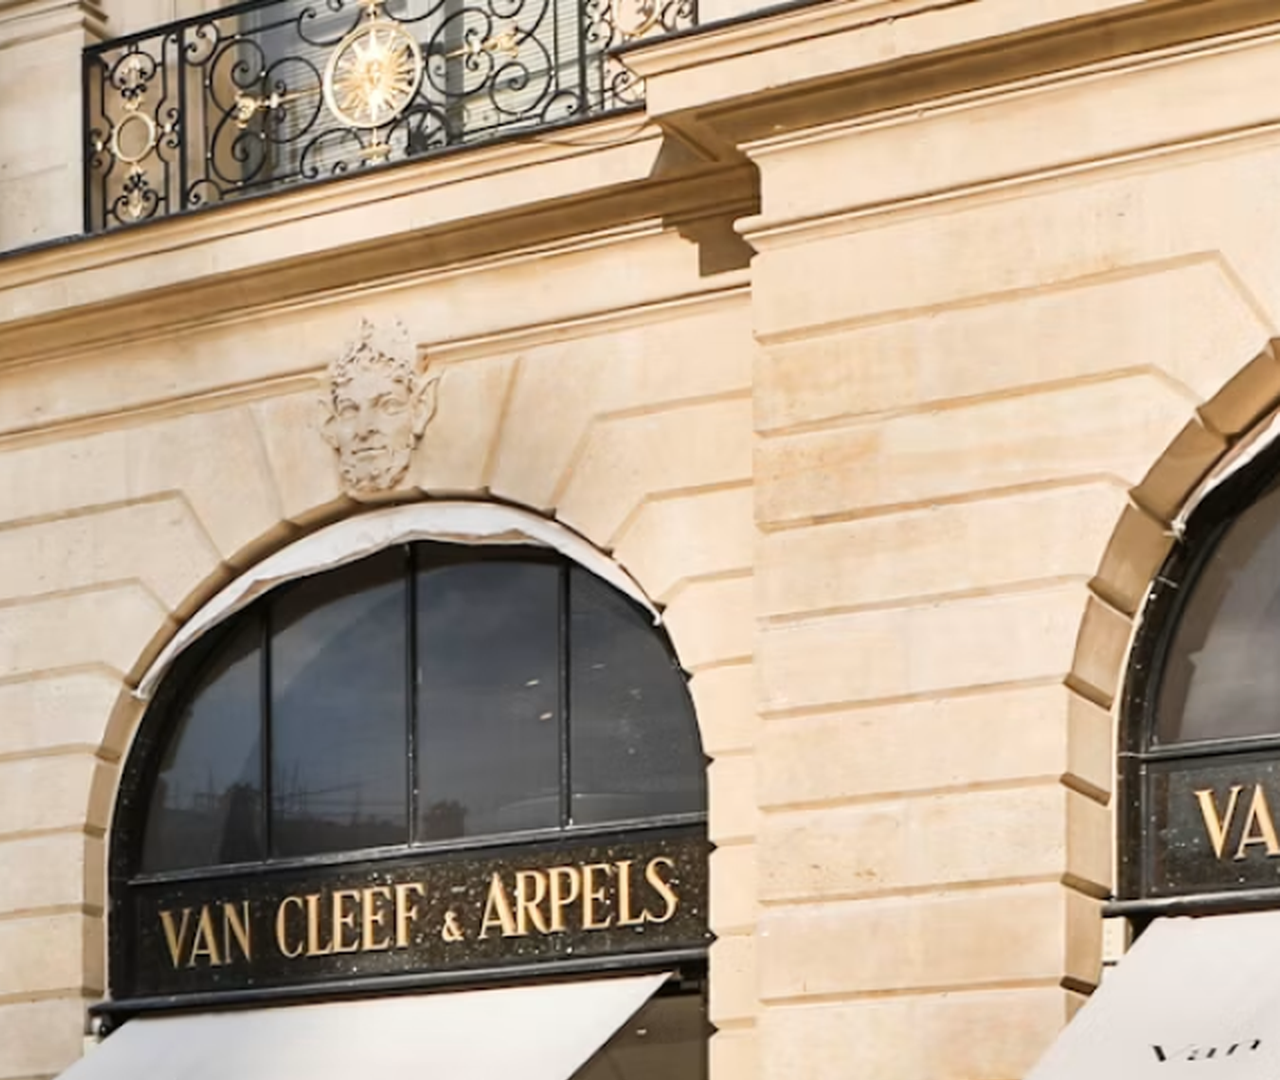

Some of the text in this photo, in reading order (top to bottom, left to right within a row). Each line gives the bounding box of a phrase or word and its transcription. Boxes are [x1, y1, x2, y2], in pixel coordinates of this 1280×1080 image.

[159, 857, 679, 968] VAN CLEEF & ARPELS
